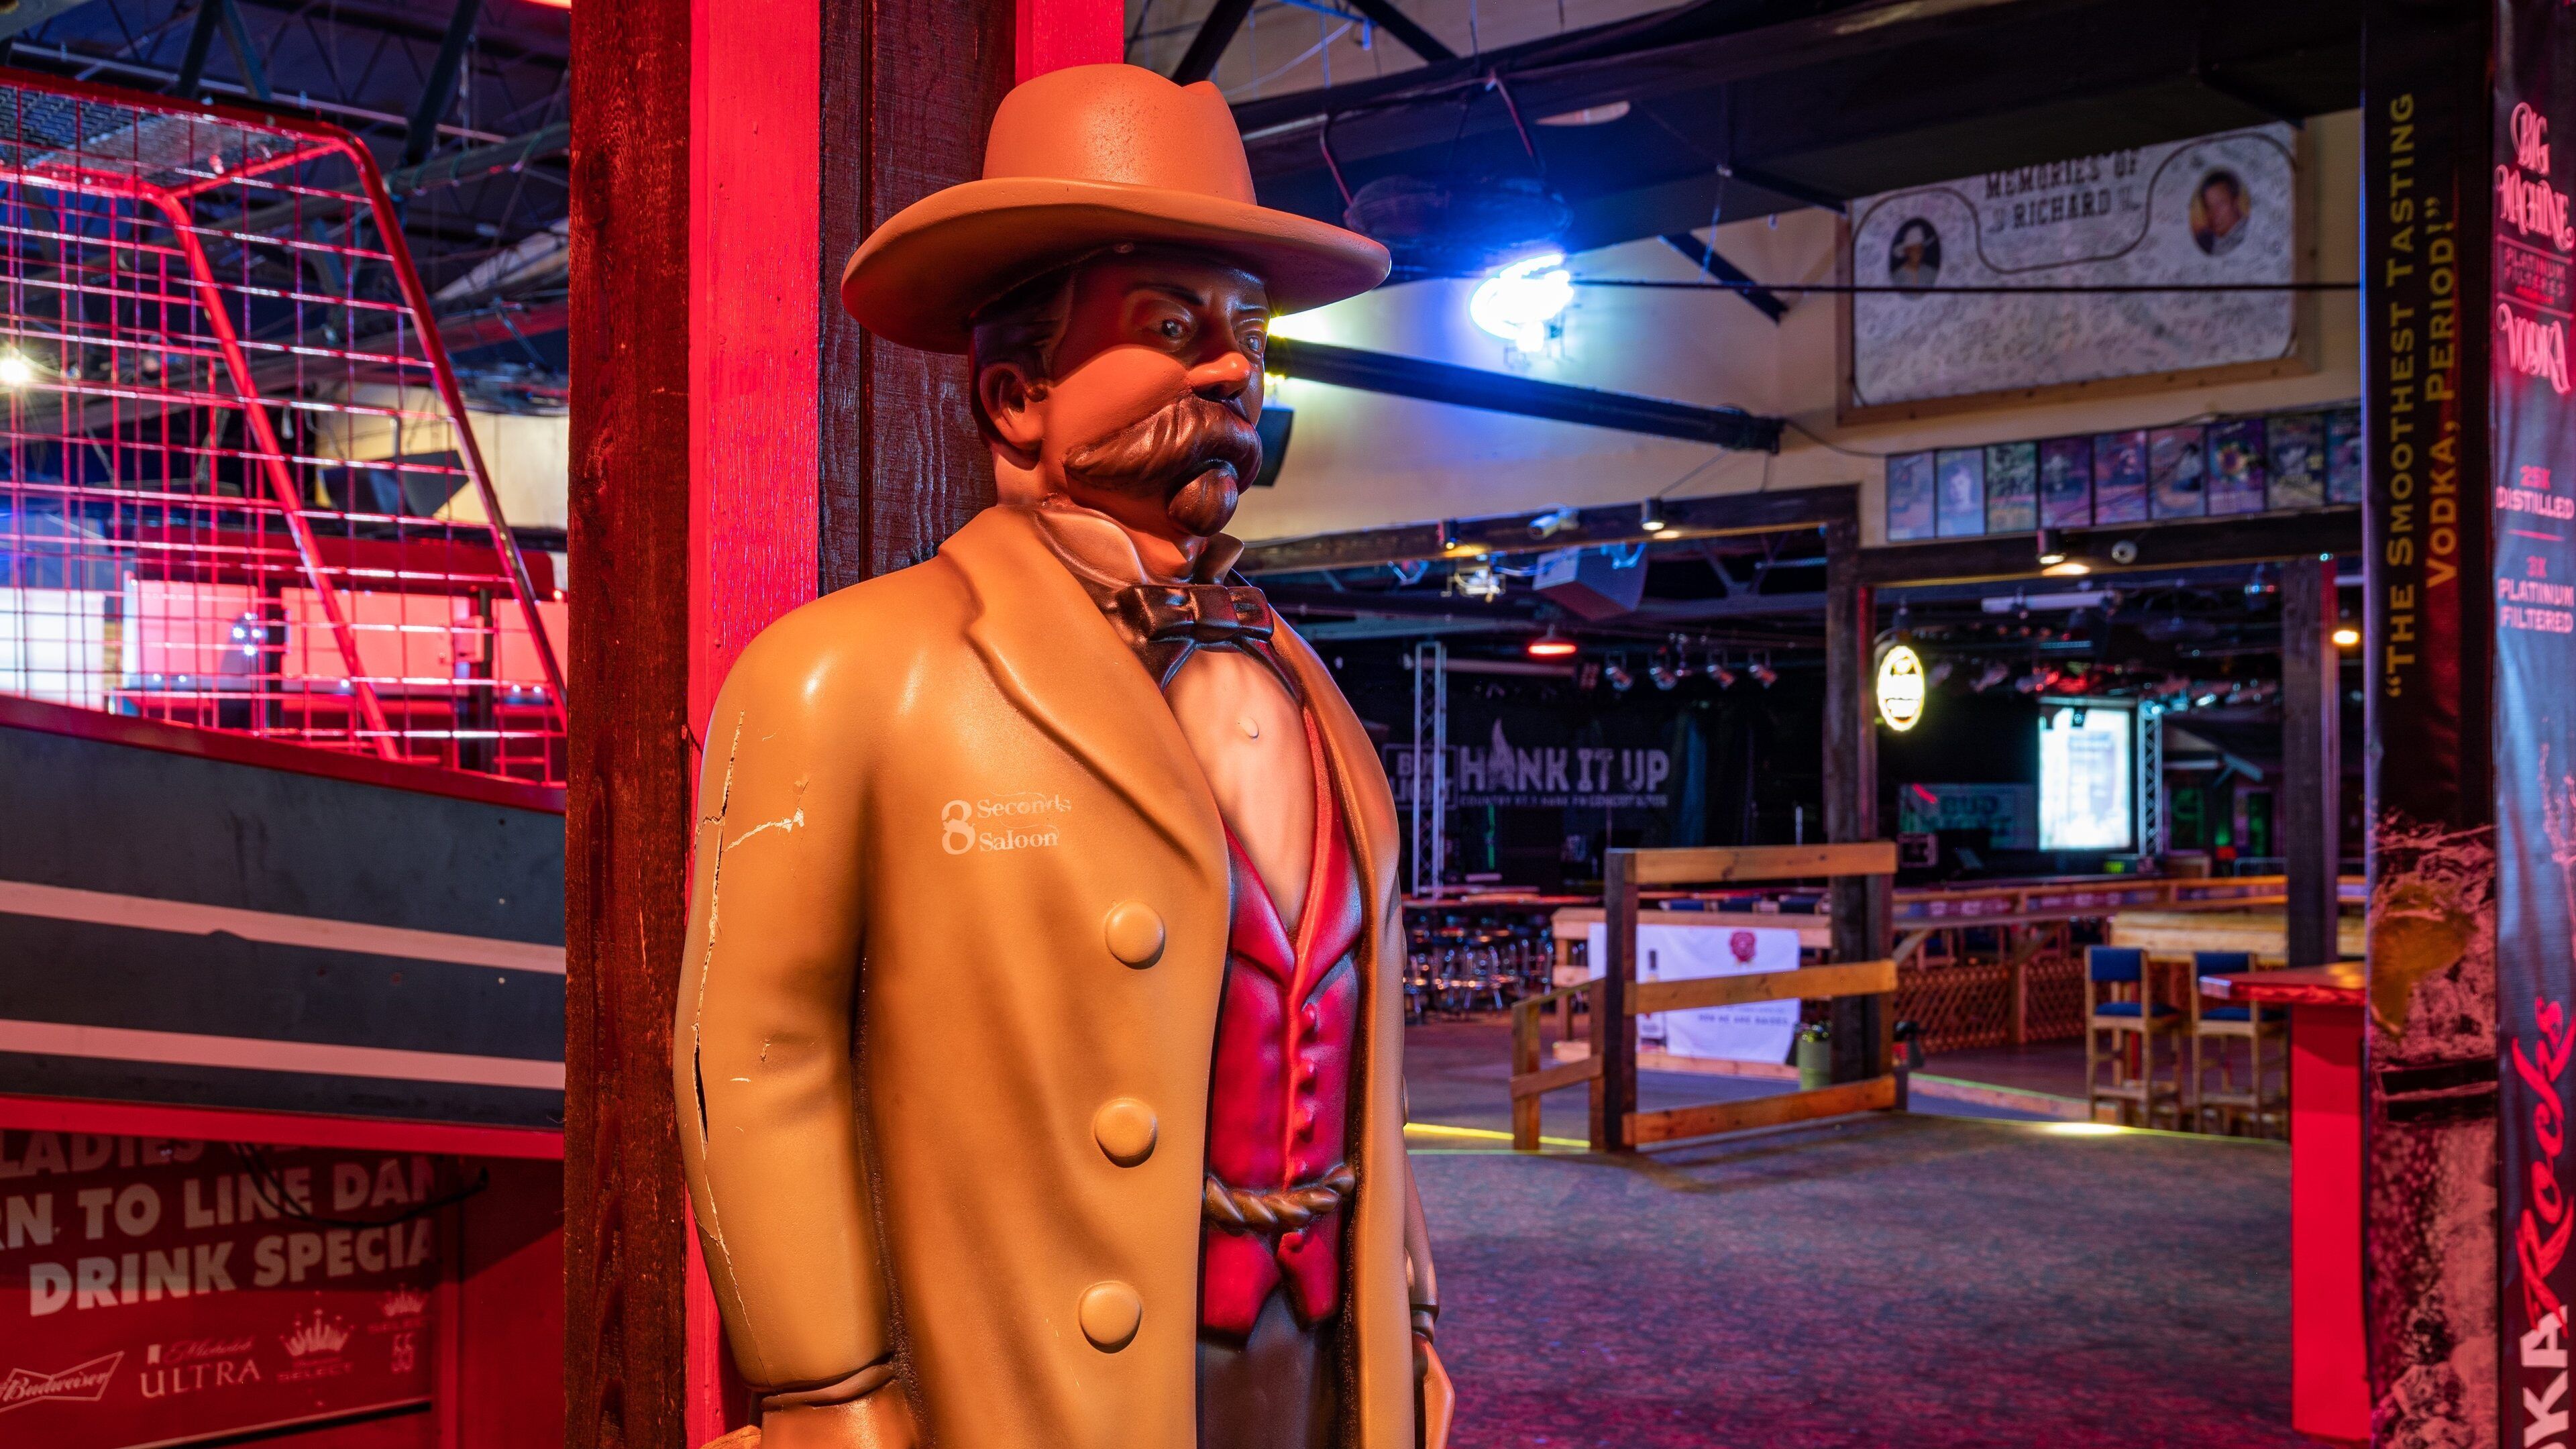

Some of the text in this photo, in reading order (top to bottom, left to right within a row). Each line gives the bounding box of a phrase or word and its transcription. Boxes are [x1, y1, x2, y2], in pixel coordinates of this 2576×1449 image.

[2013, 187, 2112, 229] RICHARD
[2385, 92, 2415, 288] TASTING
[2385, 302, 2416, 567] SMOOTHEST
[2425, 420, 2461, 589] VODKA,
[2495, 486, 2575, 521] DISTILLED
[2498, 577, 2575, 608] PLATINUM
[2500, 606, 2574, 634] FILTERED
[1459, 733, 1670, 793] HANK IT UP
[941, 800, 976, 855] 8
[979, 829, 1059, 853] Saloon
[2512, 996, 2575, 1338] Rocks
[76, 1183, 161, 1240] TO
[182, 1166, 313, 1230] LINE
[29, 1240, 237, 1317] DRINK
[1, 1371, 109, 1402] Budweiser
[140, 1358, 262, 1399] ULTRA
[2518, 1304, 2569, 1449] KA
